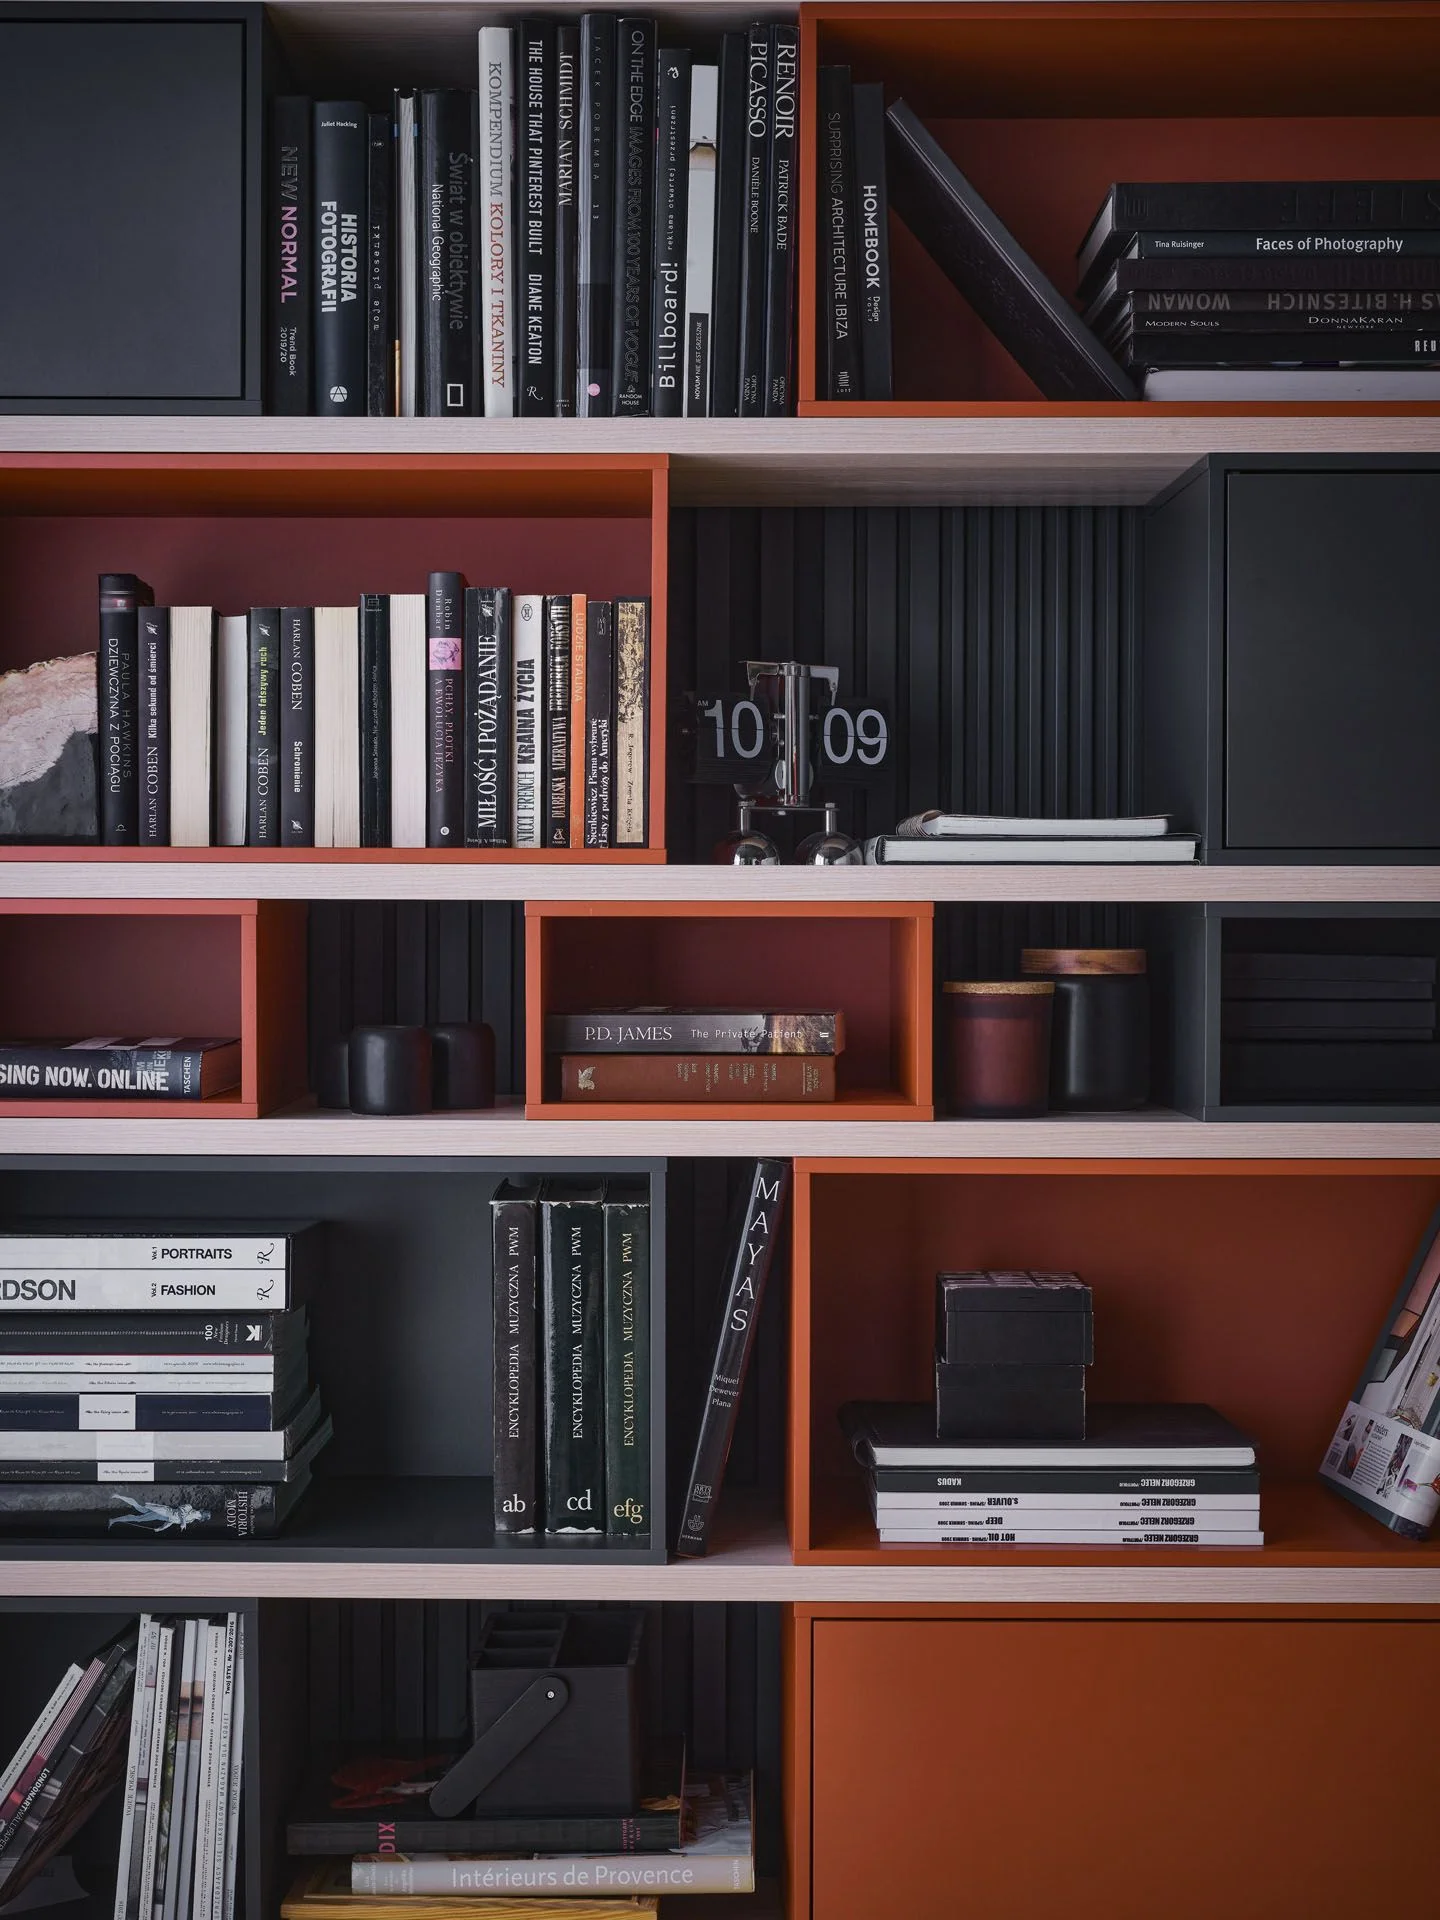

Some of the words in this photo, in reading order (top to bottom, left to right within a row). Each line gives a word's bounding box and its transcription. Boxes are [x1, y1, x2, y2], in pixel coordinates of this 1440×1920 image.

[528, 40, 543, 62] THE
[630, 30, 645, 55] ON
[528, 67, 543, 108] HOUSE
[630, 57, 645, 83] THE
[558, 51, 574, 130] SCHMIDT
[630, 86, 645, 122] EDGE
[749, 42, 767, 138] PICASSO
[775, 43, 796, 139] RENOIR
[489, 62, 503, 197] KOMPENDIUM
[528, 113, 543, 143] THAT
[668, 105, 677, 161] przestrzeni
[827, 112, 844, 193] SURPRISING
[281, 146, 298, 200] NEW
[448, 152, 473, 204] Świat
[528, 148, 543, 215] PINTEREST
[558, 140, 573, 206] MARIAN
[667, 167, 676, 208] otwartej
[750, 157, 761, 198] DANIÈLE
[777, 160, 789, 212] PATRICK
[431, 184, 444, 232] National
[749, 200, 759, 233] BOONE
[490, 203, 504, 284] KOLORY
[528, 220, 543, 255] BUILT
[666, 214, 675, 251] reklama
[777, 216, 788, 250] BADE
[831, 197, 847, 299] ARCHITECTURE
[1154, 240, 1170, 248] Tina
[1171, 240, 1204, 250] Ruisinger
[1256, 237, 1293, 251] Faces
[1297, 237, 1312, 251] of
[1314, 237, 1404, 253] Photography
[280, 206, 297, 303] NORMAL
[321, 202, 338, 312] FOTOGRAFII
[341, 213, 358, 303] HISTORIA
[373, 224, 381, 289] piosenki
[429, 237, 444, 301] Geographic
[863, 185, 880, 288] HOMEBOOK
[872, 296, 881, 321] Design
[444, 232, 469, 330] obiektywie
[528, 273, 543, 311] DIANE
[1147, 293, 1231, 311] WOMAN
[1267, 293, 1387, 311] BITESNICH
[289, 327, 298, 352] Trend
[528, 316, 543, 364] KEATON
[658, 263, 678, 389] Billboard!
[835, 304, 848, 340] IBIZA
[280, 327, 288, 362] 2019/20
[491, 300, 505, 388] TKANINY
[289, 354, 298, 376] Book
[435, 590, 444, 631] Dunbar
[444, 598, 453, 631] Robin
[549, 605, 570, 650] FORSYTH
[293, 619, 301, 658] HARLAN
[575, 613, 584, 652] LUDZIE
[147, 642, 157, 673] śmierci
[258, 646, 267, 666] ruch
[109, 638, 120, 718] DZIEWCZYNA
[121, 652, 130, 700] PAULA
[291, 662, 303, 710] COBEN
[473, 635, 501, 743] POŻĄDANIE
[513, 658, 535, 702] ŻYCIA
[548, 655, 569, 711] FREDERICK
[574, 655, 584, 703] STALINA
[148, 687, 157, 716] sekund
[434, 688, 444, 748] EWOLUCJA
[122, 709, 131, 778] HAWKINS
[148, 719, 157, 739] Kilka
[444, 722, 453, 763] PLOTKI
[516, 708, 536, 765] KRAINA
[551, 716, 567, 772] ALTERNATYWA
[588, 718, 600, 756] wybrane
[599, 718, 609, 759] Ameryki
[704, 699, 764, 759] 10
[823, 707, 889, 765] 09
[108, 737, 121, 793] POCIĄGU
[293, 741, 303, 792] Schronienie
[478, 744, 497, 754] I
[147, 746, 158, 795] COBEN
[257, 747, 269, 796] COBEN
[433, 752, 444, 793] JĘZYKA
[588, 757, 598, 785] Pisma
[473, 758, 497, 829] MIŁOŚĆ
[517, 771, 535, 811] FRENCH
[551, 776, 567, 818] DIABELSKA
[599, 776, 609, 812] podróży
[149, 797, 157, 838] HARLAN
[259, 800, 267, 839] HARLAN
[516, 816, 535, 842] NICCI
[587, 787, 598, 844] Sienkiewicz
[598, 820, 609, 843] Listy
[616, 1026, 673, 1045] JAMES
[691, 1029, 710, 1039] The
[715, 1029, 756, 1039] Private
[762, 1029, 802, 1040] Patient
[45, 1065, 93, 1088] NOW.
[97, 1067, 169, 1091] ONLINE
[183, 1056, 192, 1095] TASCHEN
[161, 1248, 232, 1260] PORTRAITS
[508, 1226, 519, 1256] PWM
[571, 1226, 582, 1256] PWM
[622, 1233, 633, 1263] PWM
[731, 1177, 781, 1333] MAYAS
[0, 1279, 76, 1301] DSON
[161, 1284, 216, 1296] FASHION
[508, 1265, 519, 1334] MUZYCZNA
[571, 1265, 582, 1334] MUZYCZNA
[622, 1271, 634, 1341] MUZYCZNA
[205, 1325, 214, 1341] 100
[508, 1344, 520, 1439] ENCYKLOPEDIA
[572, 1344, 583, 1439] ENCYKLOPEDIA
[622, 1351, 634, 1446] ENCYKLOPEDIA
[715, 1374, 740, 1385] Miquel
[711, 1398, 732, 1408] Plana
[566, 1489, 592, 1511] cd
[937, 1477, 962, 1486] KADUS
[1141, 1479, 1160, 1487] NELEC
[1161, 1479, 1195, 1487] GRZEGORZ
[226, 1499, 237, 1529] MODY
[238, 1491, 248, 1537] HISTORIA
[502, 1493, 526, 1513] ab
[613, 1497, 644, 1524] efg
[986, 1516, 1003, 1525] DEEP
[1140, 1517, 1160, 1526] NELEC
[1142, 1498, 1161, 1507] NELEC
[1161, 1517, 1195, 1526] GRZEGORZ
[1162, 1498, 1197, 1507] GRZEGORZ
[1001, 1533, 1016, 1541] HOT
[1144, 1534, 1164, 1543] NELEC
[1165, 1534, 1199, 1543] GRZEGORZ
[127, 1766, 136, 1792] POLSKA
[378, 1822, 396, 1854] DIX
[451, 1865, 559, 1889] Intérieurs
[562, 1865, 587, 1887] de
[594, 1866, 694, 1886] Provence
